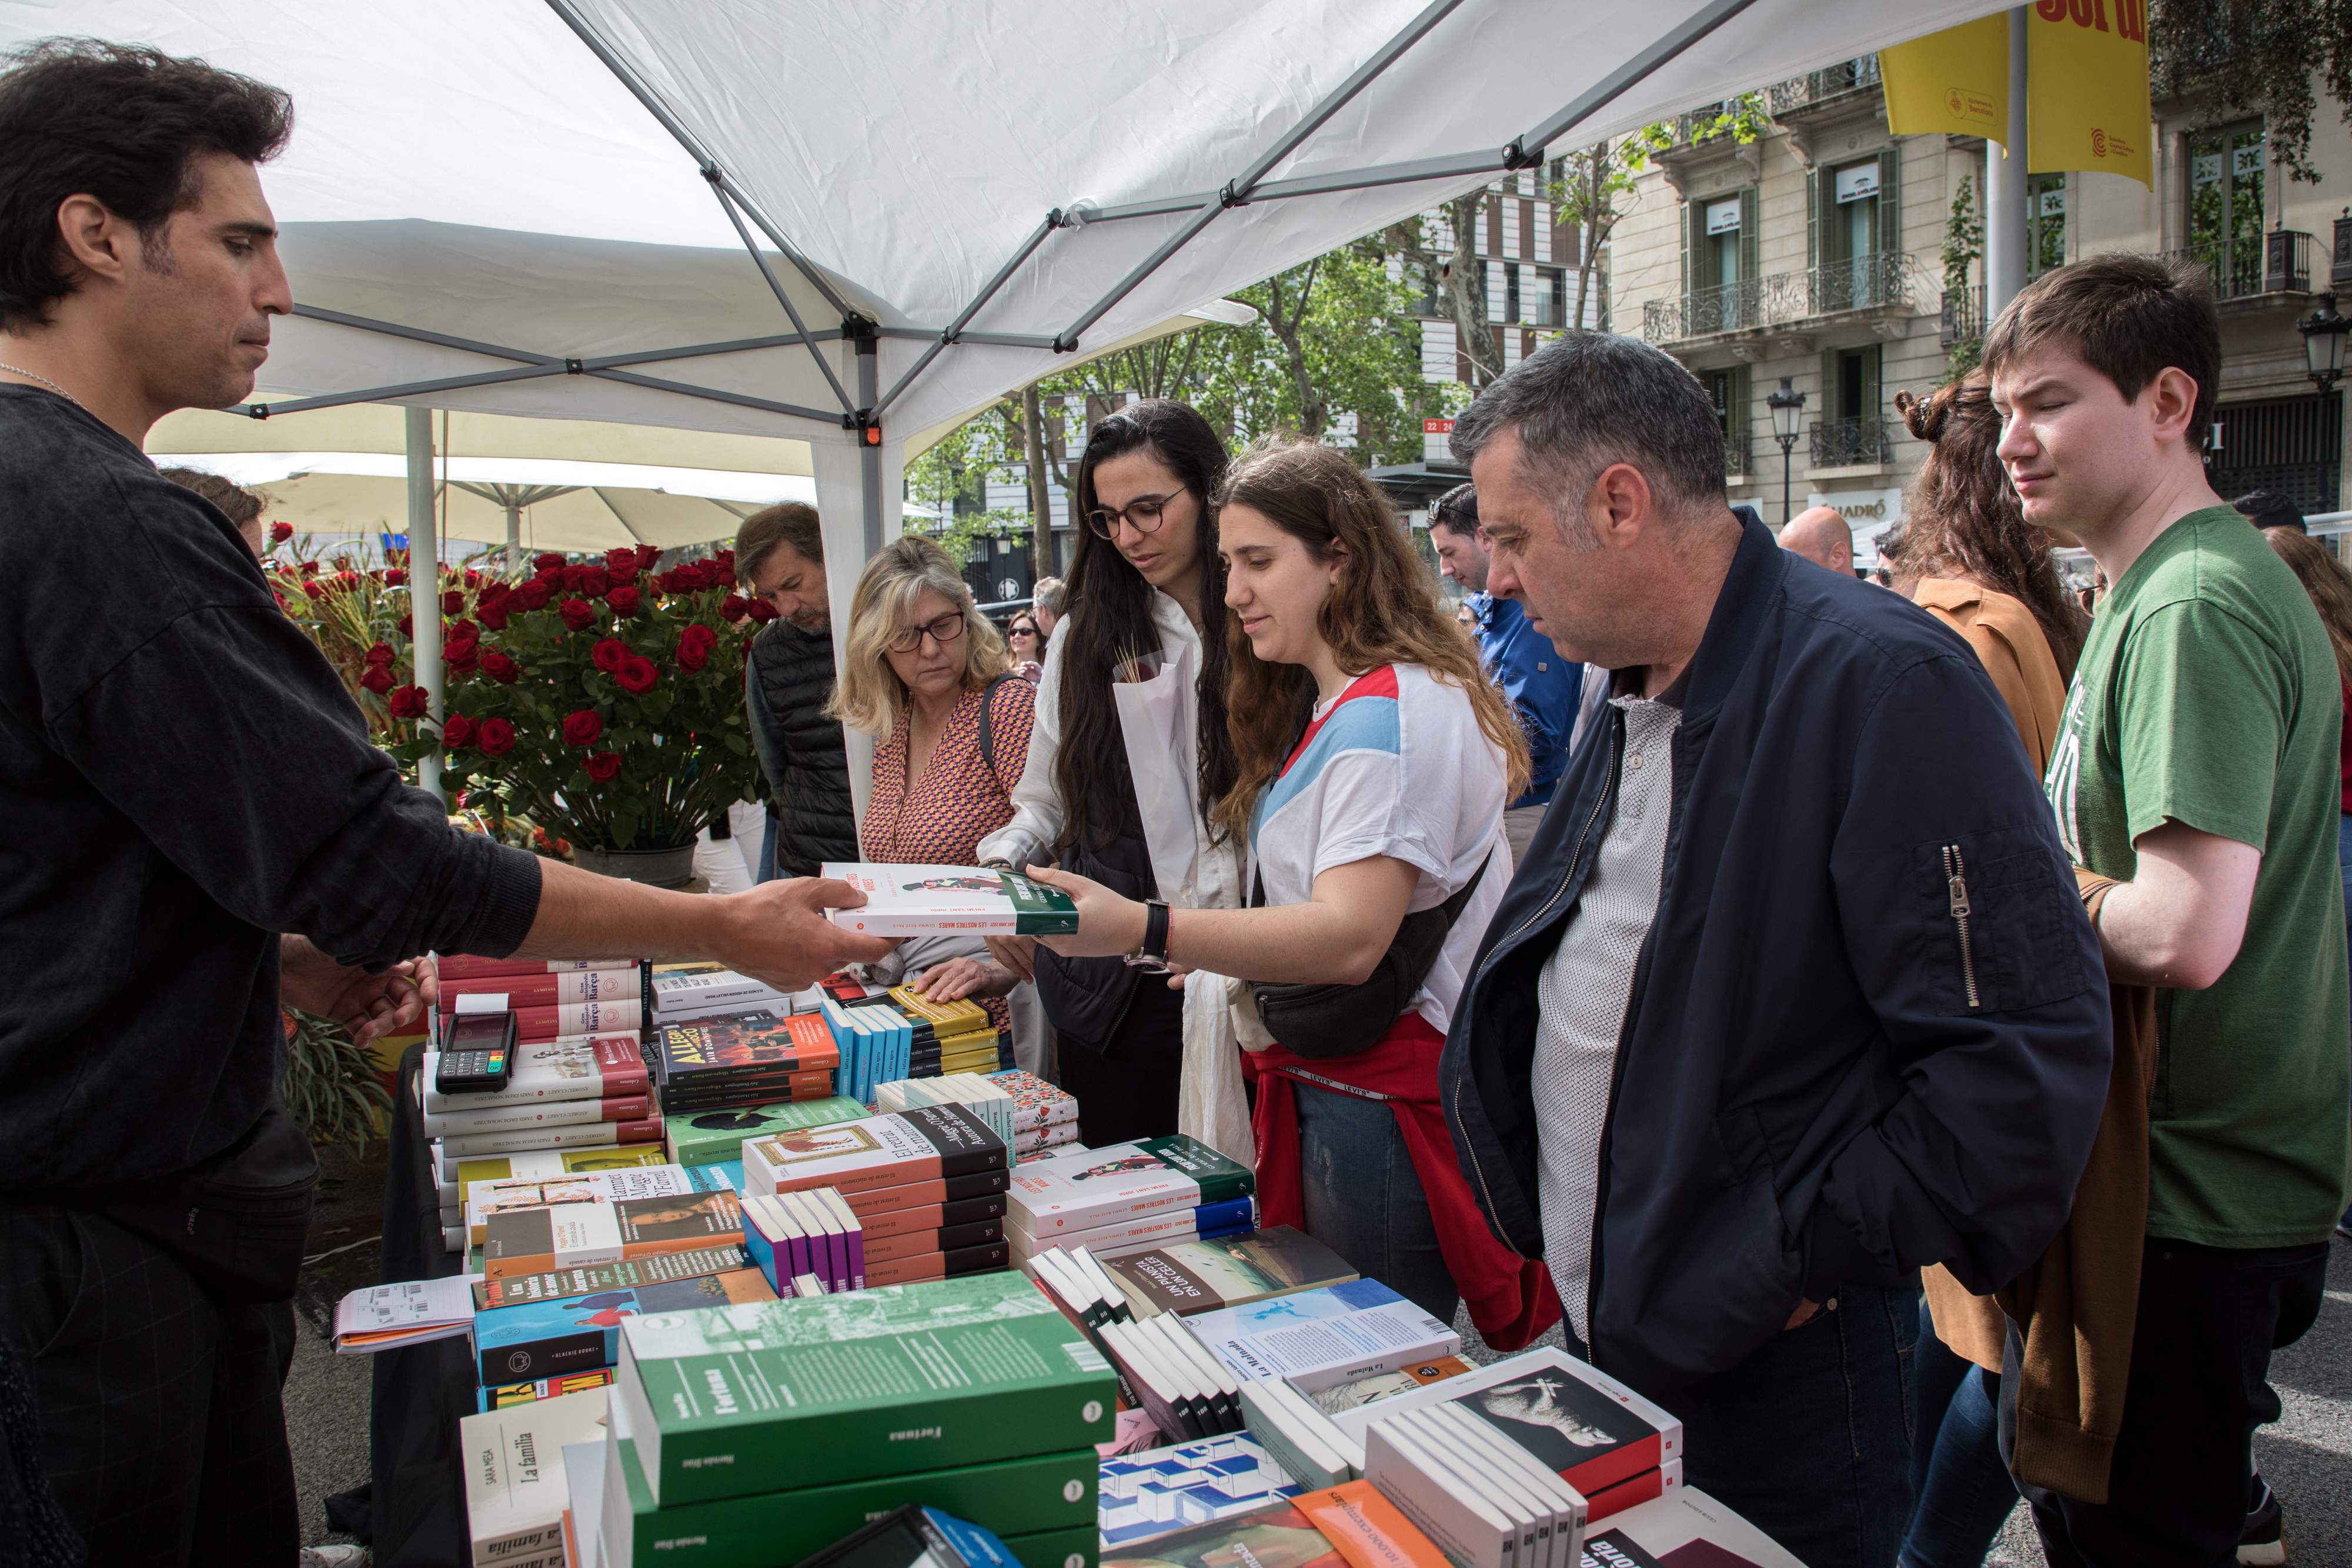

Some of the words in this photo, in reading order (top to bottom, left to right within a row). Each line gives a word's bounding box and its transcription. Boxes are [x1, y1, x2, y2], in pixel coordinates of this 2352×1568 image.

[1427, 422, 1436, 430] 22
[1444, 423, 1452, 431] 24
[862, 879, 876, 891] MARES
[590, 1004, 599, 1031] Barça
[668, 1029, 706, 1064] ALLEGRO
[707, 1051, 718, 1063] JAIR
[915, 1108, 946, 1122] O'Farrell
[932, 1104, 962, 1120] Hamnet
[880, 1112, 927, 1145] matrimoni
[879, 1129, 907, 1147] retrat
[962, 1126, 987, 1146] Autora
[492, 1139, 521, 1148] NOSALTRES
[917, 1144, 934, 1154] de
[894, 1147, 914, 1158] El
[1182, 1162, 1201, 1171] PREMI
[1195, 1157, 1216, 1169] GEMMA
[688, 1166, 706, 1182] Lorenzo
[840, 1176, 867, 1185] matrimoni
[1011, 1176, 1035, 1188] NOSTRES
[1032, 1177, 1050, 1188] MARES
[1147, 1199, 1165, 1208] NOSTRES
[1128, 1228, 1143, 1236] MARES
[1144, 1225, 1162, 1233] NOSTRES
[721, 1249, 736, 1265] MANUEL
[1135, 1260, 1173, 1285] PIANISTA
[1144, 1256, 1177, 1277] CELLER
[524, 1276, 542, 1298] historia
[543, 1274, 557, 1288] amor
[572, 1269, 589, 1292] Juarma
[1171, 1275, 1188, 1286] UN
[482, 1281, 504, 1306] Punki
[509, 1283, 523, 1296] Una
[1166, 1285, 1184, 1296] UN
[1183, 1286, 1201, 1296] EN
[1227, 1340, 1259, 1367] Malnada
[1258, 1366, 1271, 1377] La
[1347, 1366, 1371, 1378] Malnada
[1372, 1363, 1383, 1373] La
[1117, 1374, 1134, 1395] Baltasar
[1128, 1393, 1137, 1406] Eva
[889, 1426, 942, 1443] Fortuna
[514, 1432, 537, 1467] familia
[483, 1448, 494, 1467] MESA
[705, 1454, 734, 1467] Hernán
[484, 1469, 497, 1486] SARA
[520, 1470, 539, 1484] La
[1681, 1499, 1702, 1514] EDITOR
[1327, 1492, 1373, 1536] exemplars
[1701, 1512, 1717, 1524] CLUB
[488, 1532, 543, 1554] familia
[677, 1535, 707, 1548] Hernán
[1367, 1527, 1401, 1564] 10.000
